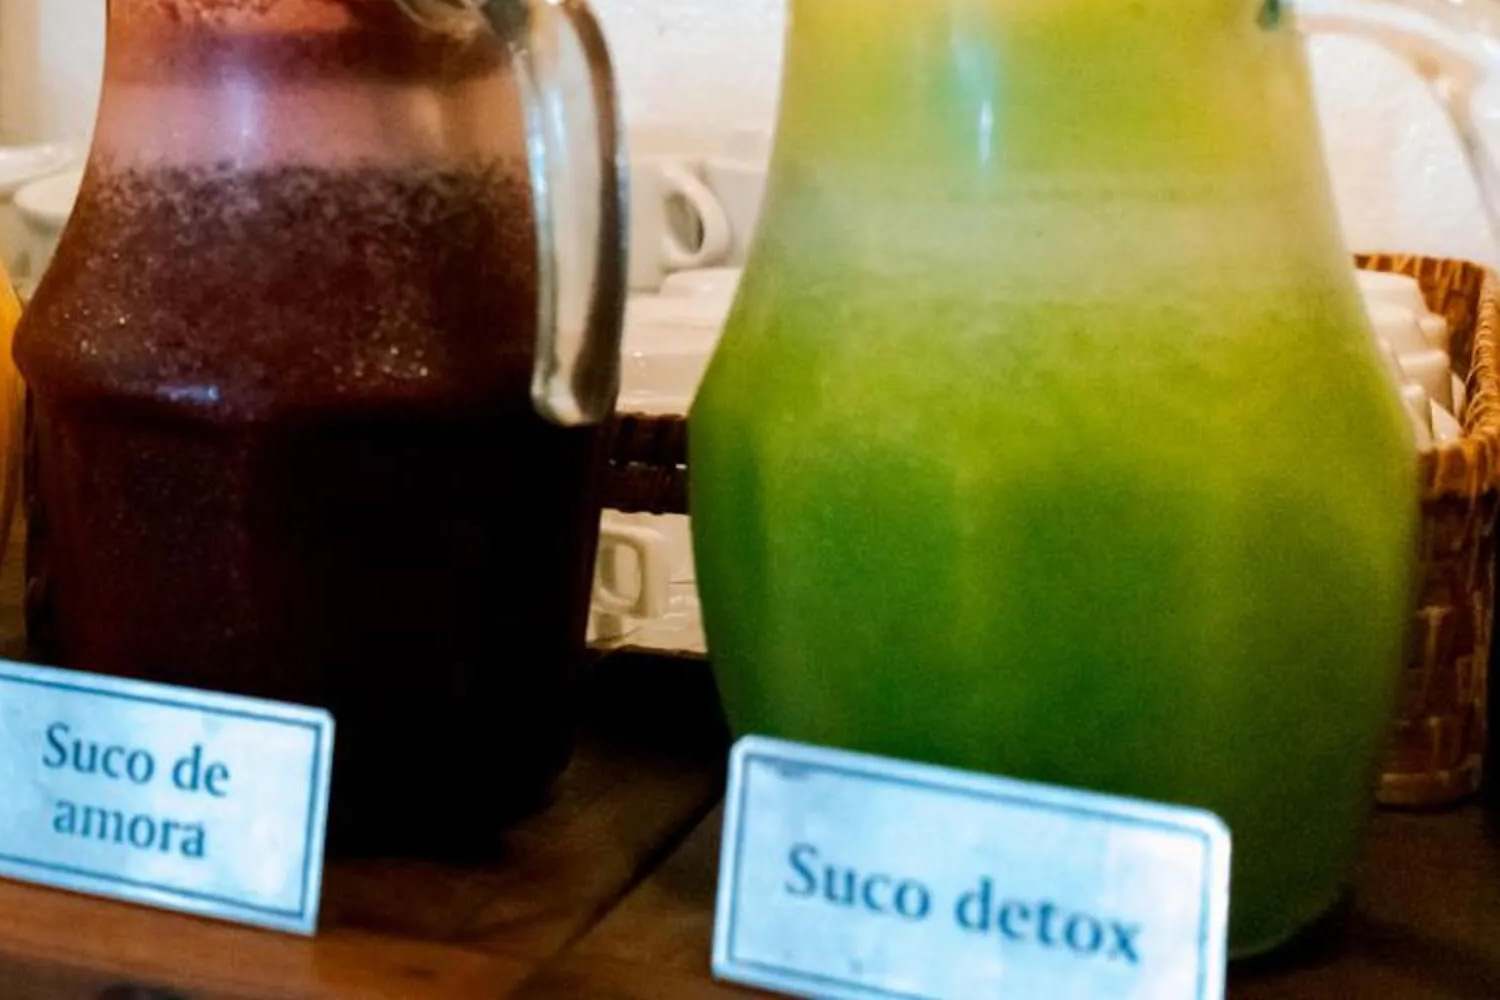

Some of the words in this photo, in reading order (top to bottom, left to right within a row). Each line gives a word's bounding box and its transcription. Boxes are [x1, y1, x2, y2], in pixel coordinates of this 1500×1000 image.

[42, 722, 155, 785] Suco
[172, 745, 231, 797] de
[52, 797, 207, 859] amora
[784, 842, 932, 922] Suco
[954, 875, 1144, 966] detox
